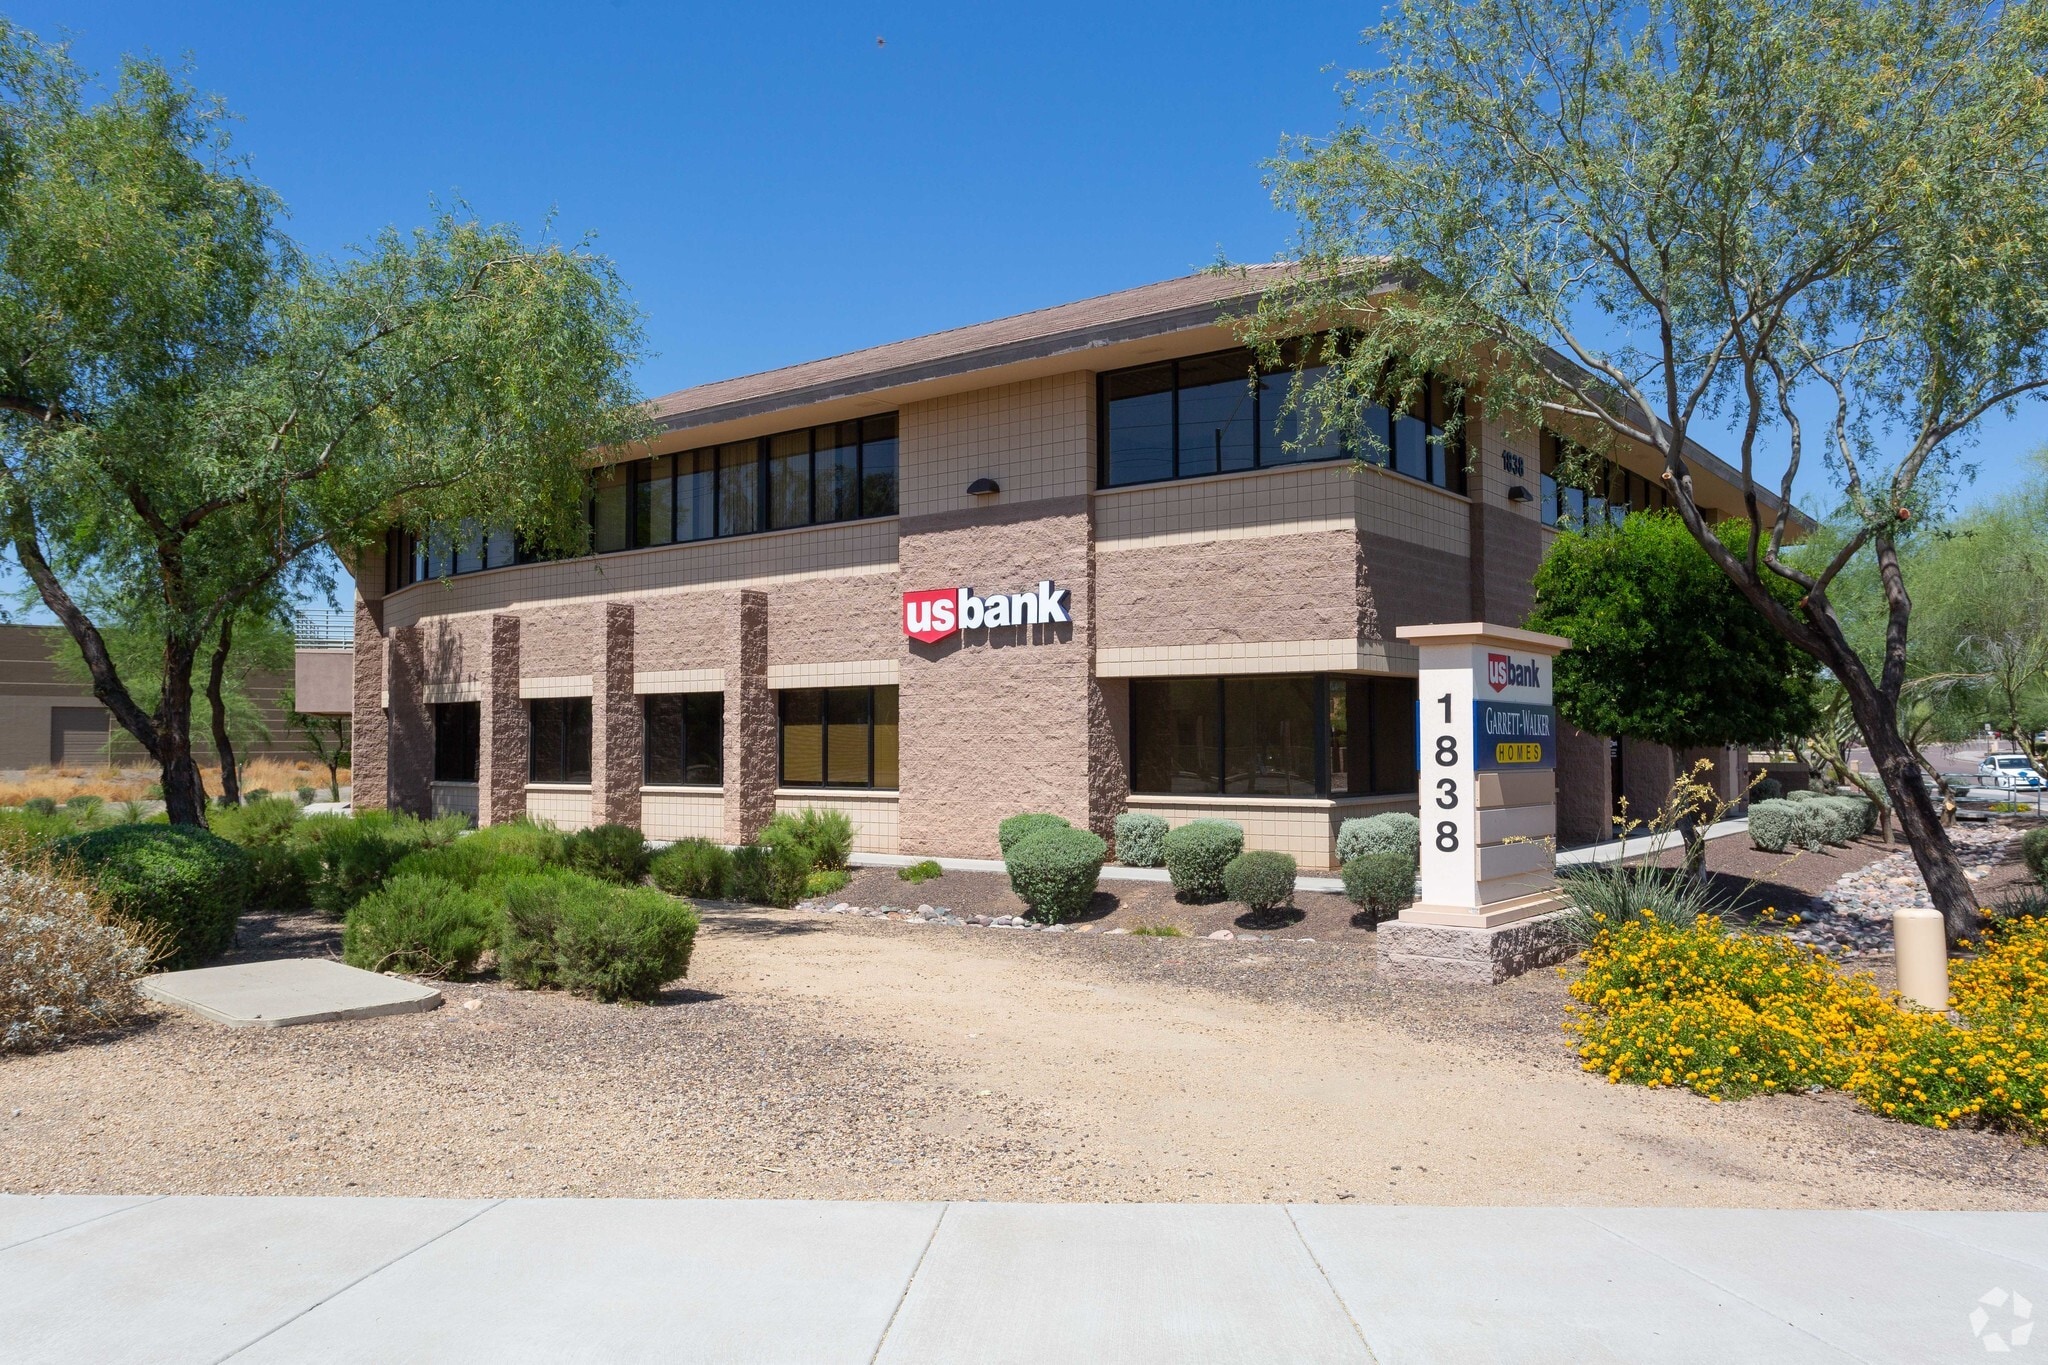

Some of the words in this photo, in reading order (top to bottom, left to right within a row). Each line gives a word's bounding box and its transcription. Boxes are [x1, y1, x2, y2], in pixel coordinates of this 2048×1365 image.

[1502, 449, 1524, 477] 1838
[1485, 706, 1550, 737] GARRETT-WALKER
[1499, 744, 1539, 761] HOMES
[1435, 693, 1459, 852] 1838
